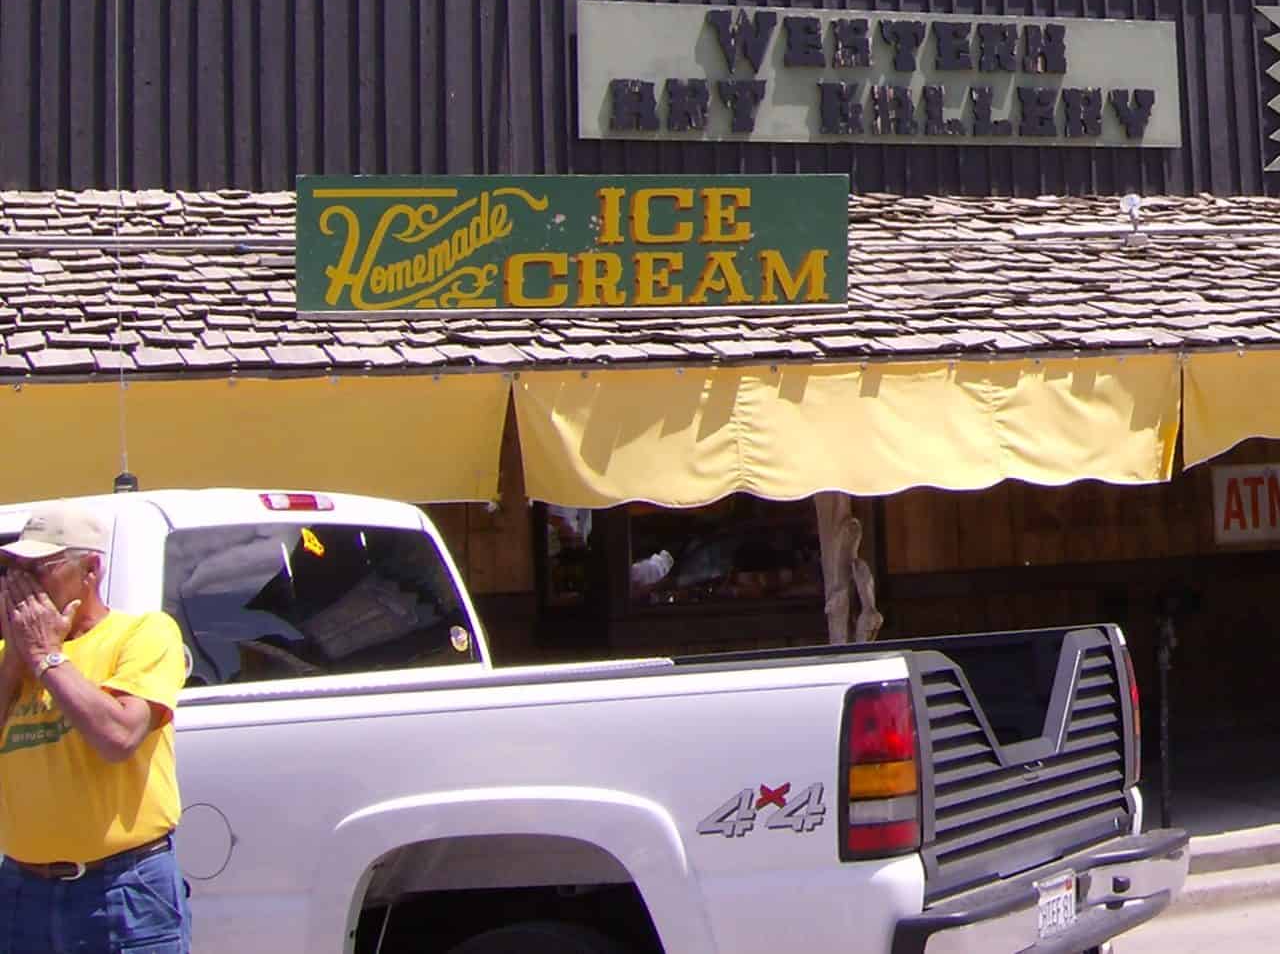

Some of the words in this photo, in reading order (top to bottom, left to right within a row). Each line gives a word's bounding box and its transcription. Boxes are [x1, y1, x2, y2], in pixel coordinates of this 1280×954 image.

[705, 9, 1067, 74] WESTERN
[607, 78, 766, 135] ART
[816, 81, 1155, 139] GALLERY
[599, 187, 752, 244] ICE
[320, 189, 518, 311] Homemade
[504, 249, 830, 308] CREAM
